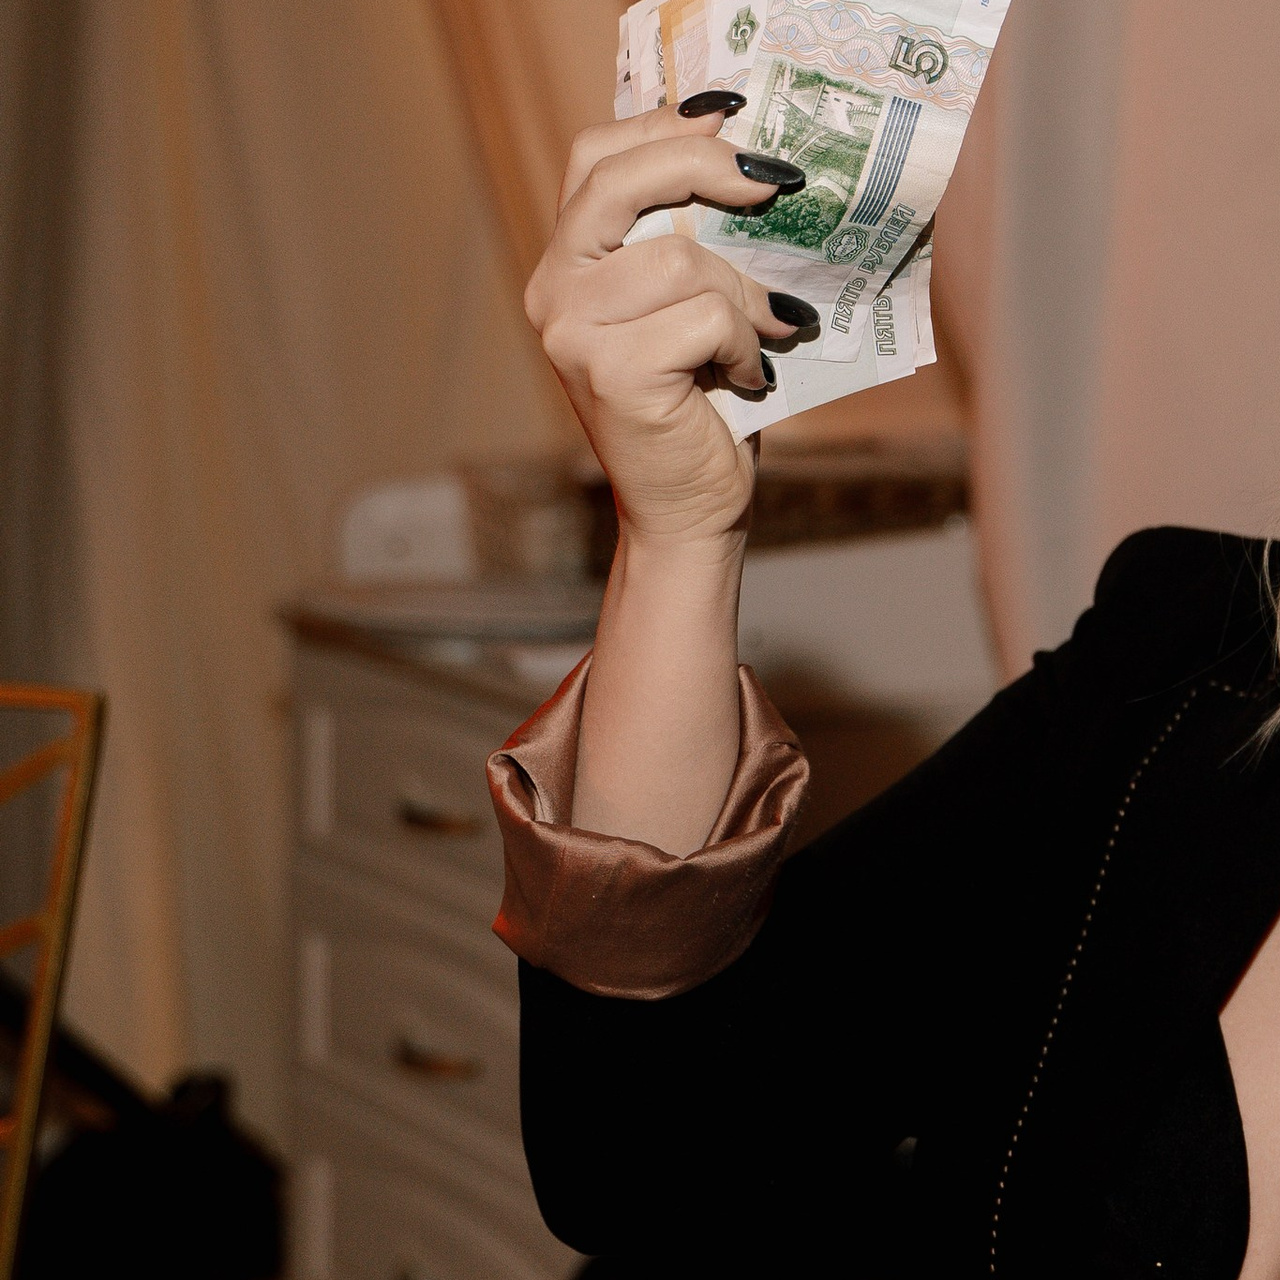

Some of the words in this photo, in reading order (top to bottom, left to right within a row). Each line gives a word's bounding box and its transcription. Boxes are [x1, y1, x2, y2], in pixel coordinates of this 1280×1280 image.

[731, 24, 752, 42] 5
[888, 35, 949, 85] 5
[831, 276, 868, 334] ПЯТЬ
[858, 202, 917, 275] РУБЛЕЙ
[871, 294, 897, 356] ПЯТЬ
